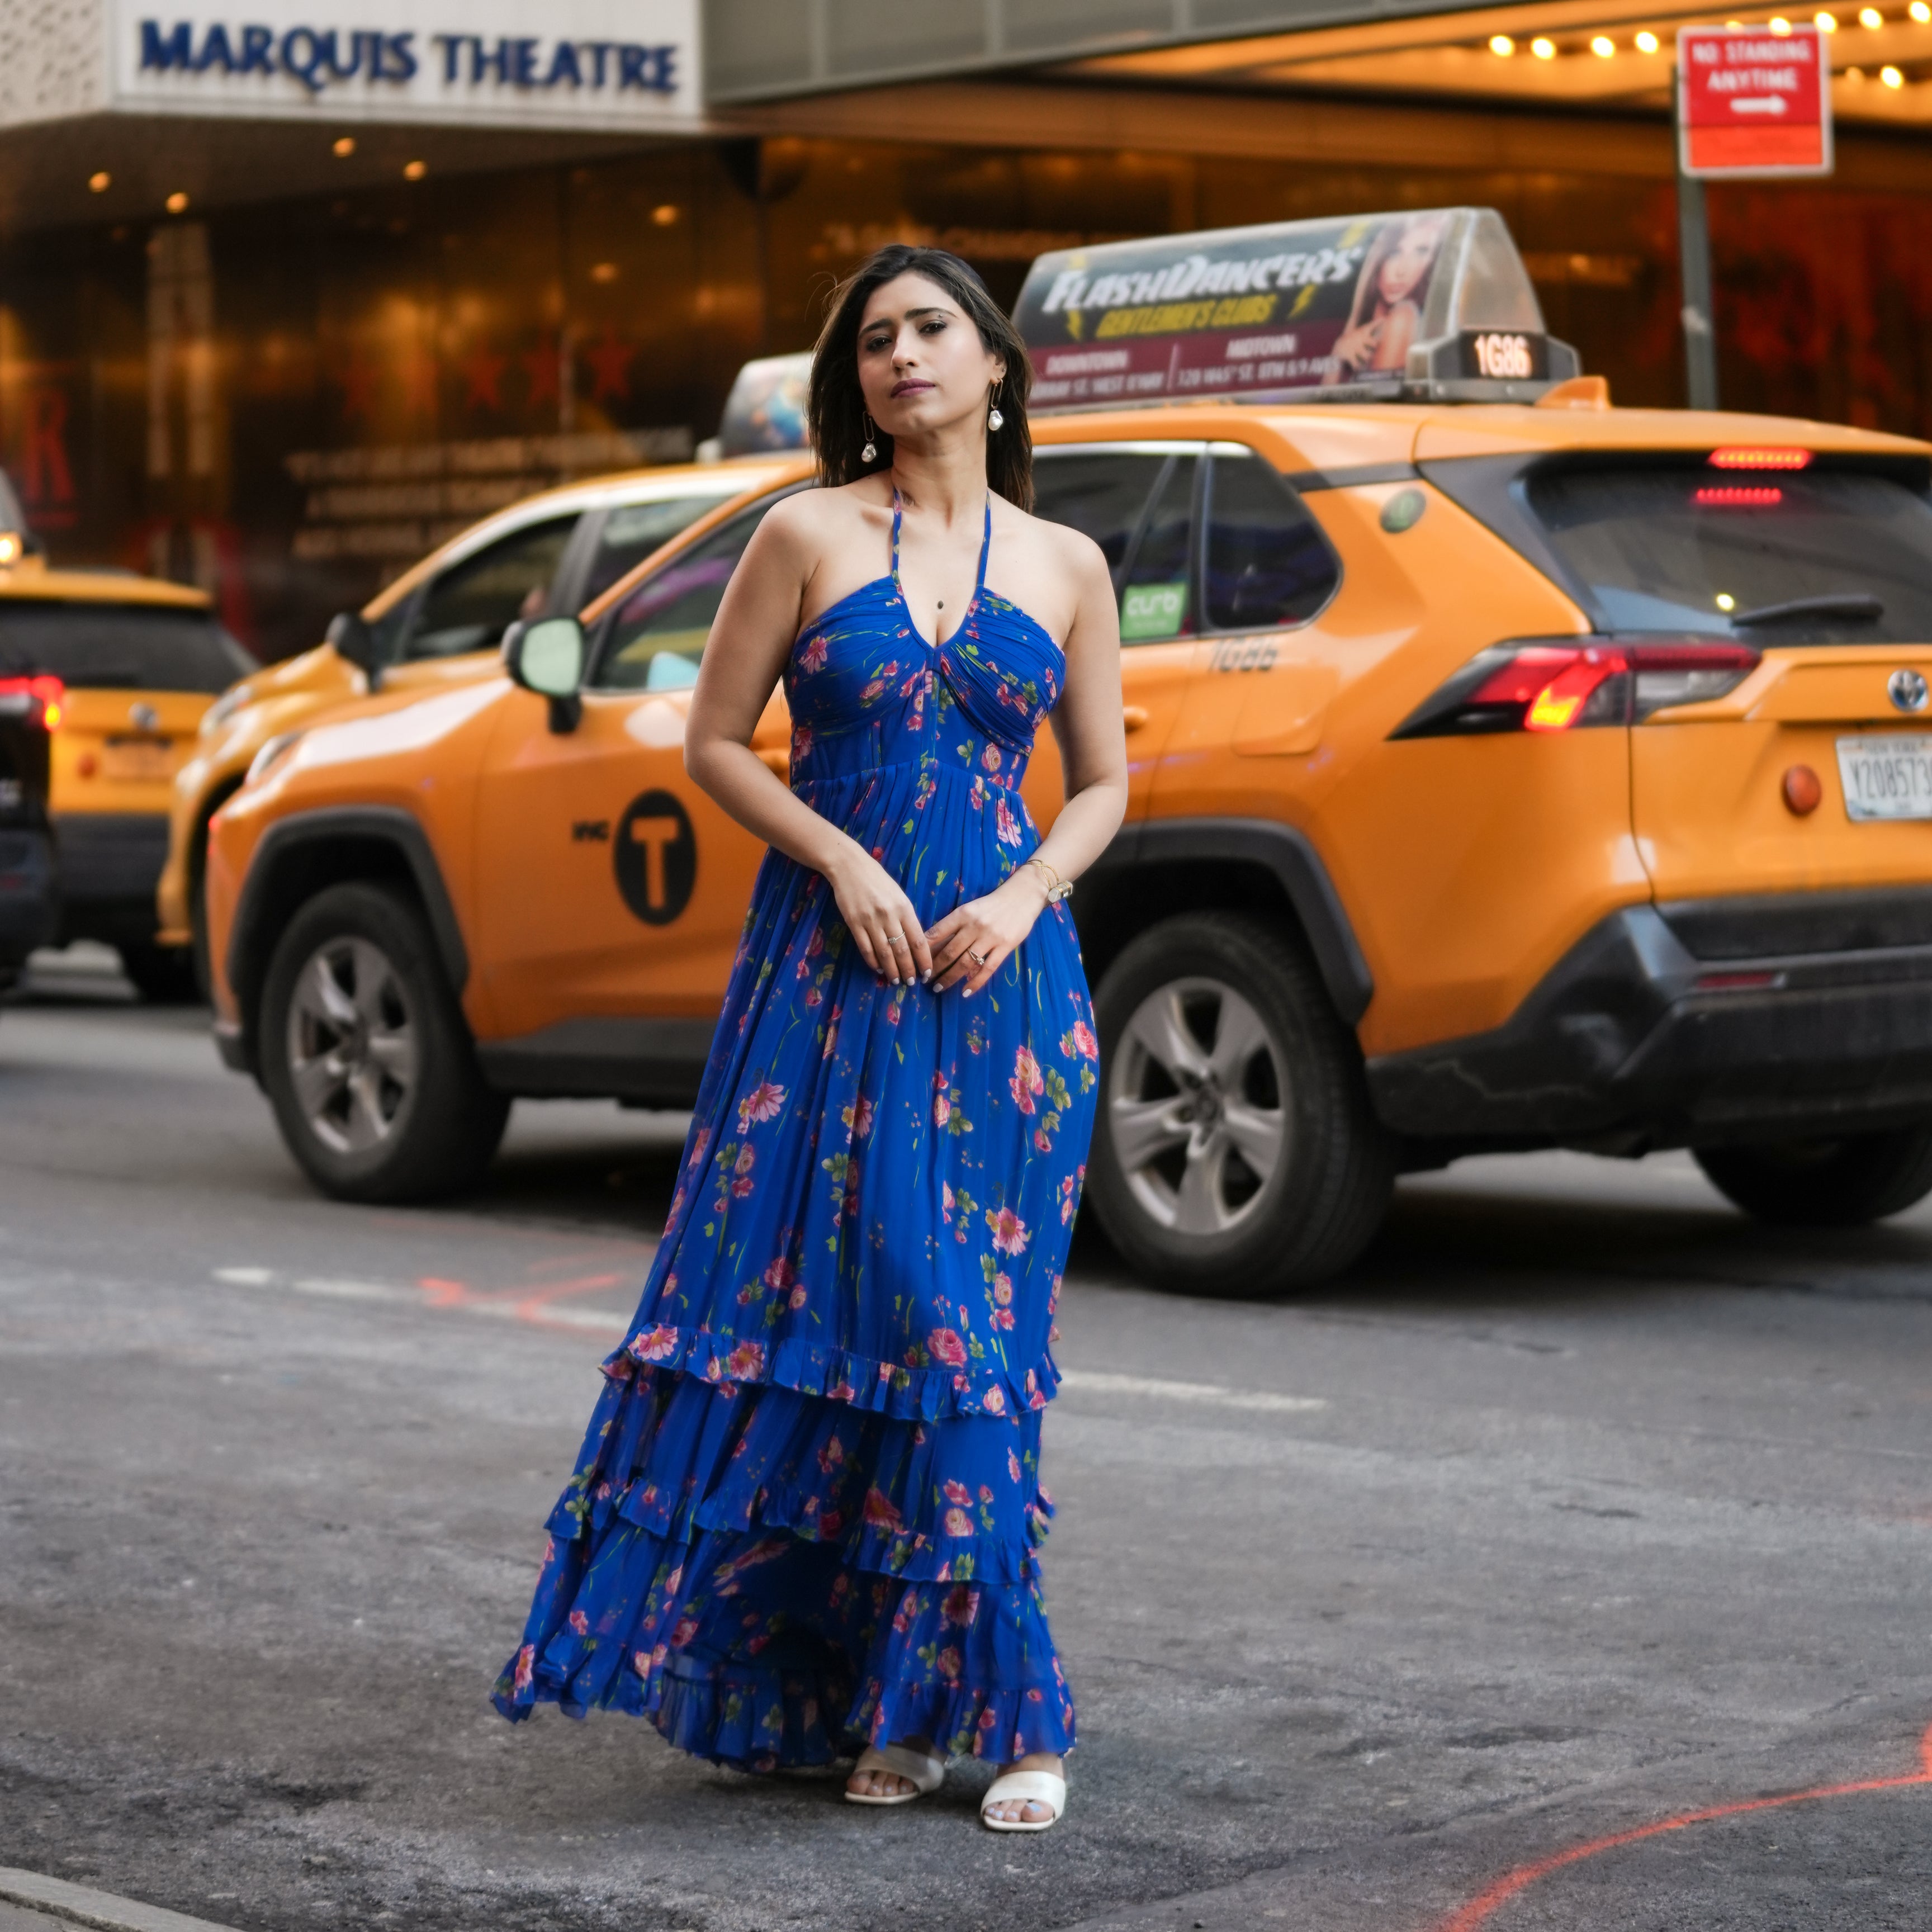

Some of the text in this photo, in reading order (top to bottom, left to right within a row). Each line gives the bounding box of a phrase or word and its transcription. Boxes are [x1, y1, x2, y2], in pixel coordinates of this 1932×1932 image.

[140, 20, 680, 92] MARQUIS THEATRE
[1692, 41, 1718, 63] NO
[1707, 68, 1798, 91] ANYTIME
[1475, 334, 1531, 376] 1G86
[1848, 757, 1932, 799] Y208573
